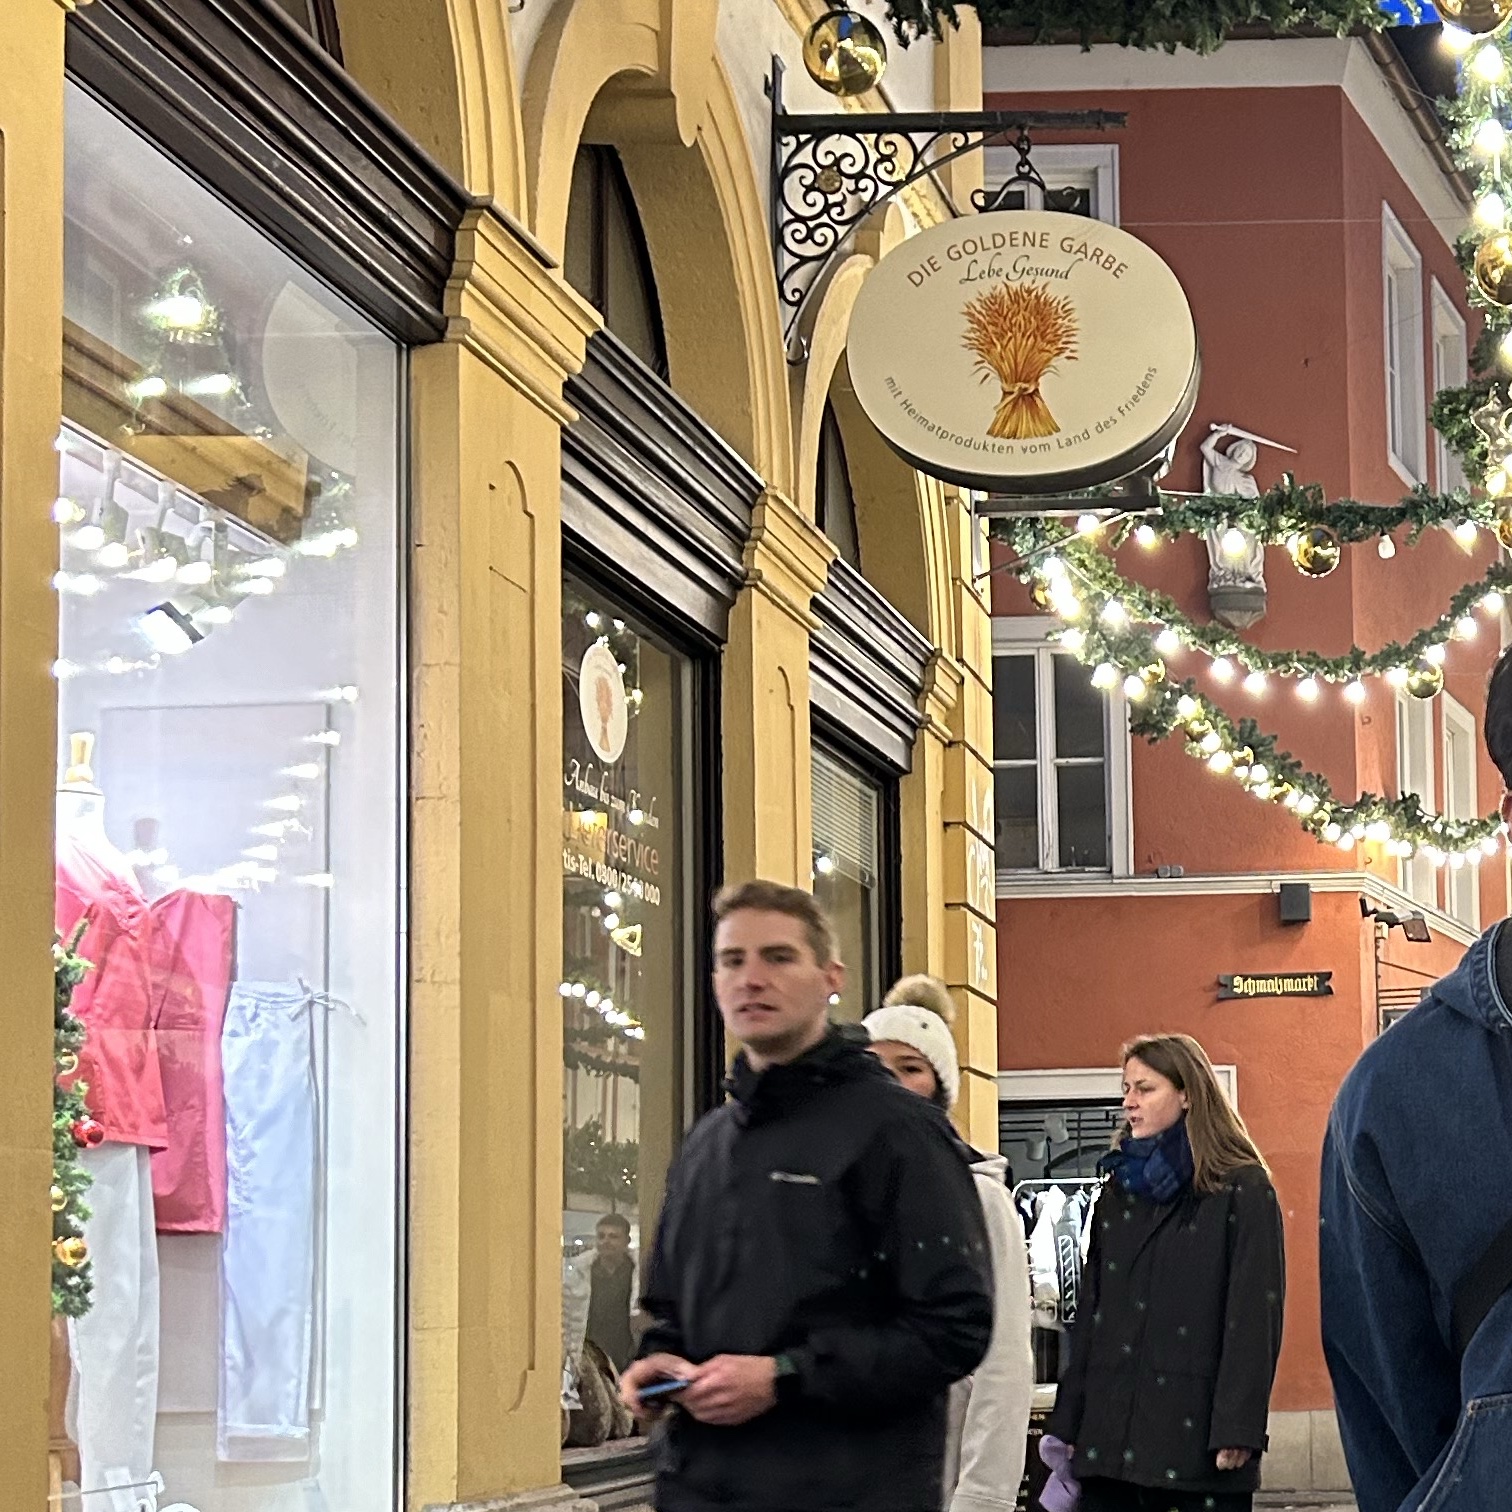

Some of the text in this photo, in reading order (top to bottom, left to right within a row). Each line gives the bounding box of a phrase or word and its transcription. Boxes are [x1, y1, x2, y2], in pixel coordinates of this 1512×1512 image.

[905, 230, 1130, 288] DIE GOLDENE GARBE
[958, 252, 1083, 285] Lebe Gesund
[883, 364, 1159, 455] mit Heimatprodukten vom Land des Friedens
[626, 789, 660, 829] Knden
[1232, 974, 1320, 996] Schmalzmarkt
